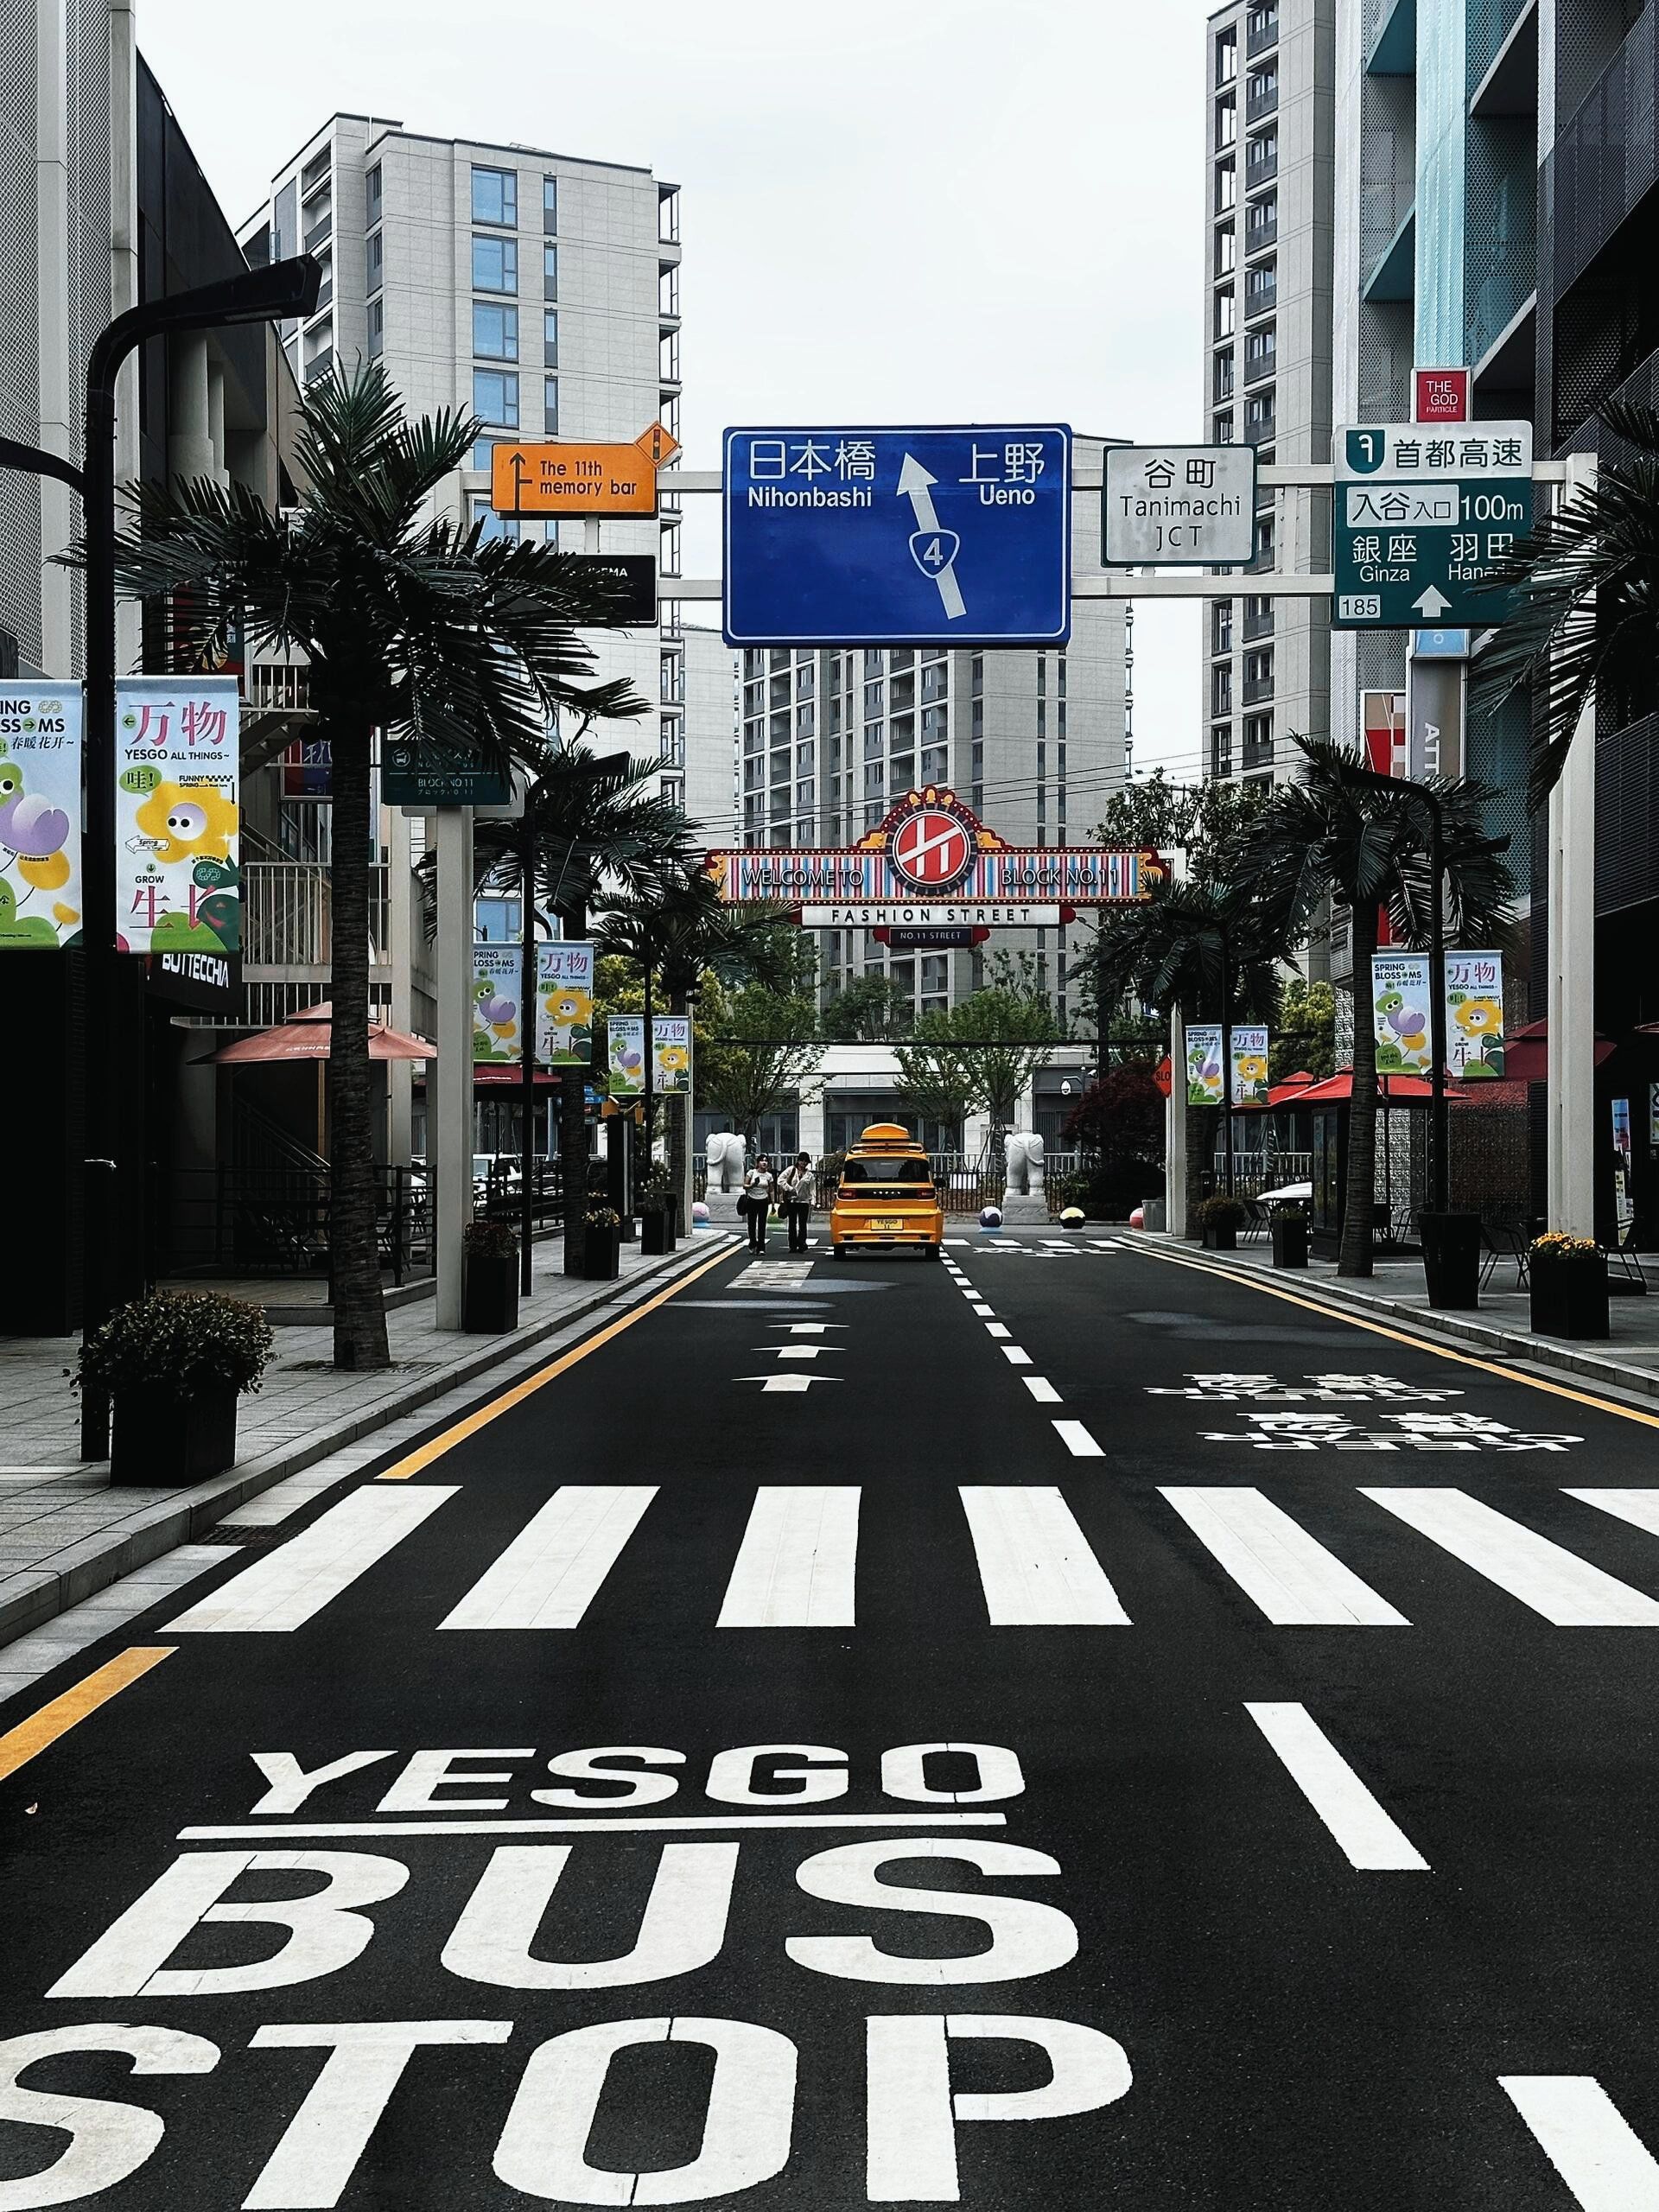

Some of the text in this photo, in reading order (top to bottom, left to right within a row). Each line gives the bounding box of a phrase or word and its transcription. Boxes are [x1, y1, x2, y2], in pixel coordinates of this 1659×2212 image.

[1426, 381, 1452, 392] THE
[1430, 394, 1458, 405] GOD
[748, 439, 875, 481] 日本橋
[1393, 438, 1522, 468] 首都高速
[540, 461, 602, 476] The 11th
[958, 443, 1044, 484] 上野
[1144, 459, 1217, 489] 谷町
[540, 480, 637, 497] memory bar
[747, 486, 872, 507] Nihonbashi
[979, 485, 1035, 505] Ueno
[1120, 494, 1241, 517] Tanimachi
[1460, 494, 1523, 520] 100m
[1155, 525, 1202, 552] JCT
[1352, 533, 1417, 563] 銀座
[923, 538, 944, 566] 4
[1360, 563, 1512, 582] Ginza Hane
[1343, 598, 1377, 616] 185
[129, 701, 227, 746] 万物
[124, 749, 168, 760] YESGO
[743, 868, 863, 886] WELCOME TO
[1001, 868, 1118, 885] BLOCK NO.11
[831, 908, 1030, 922] FASHION STREET
[543, 952, 588, 973] 万物
[1375, 963, 1405, 971] SPRING
[1451, 962, 1495, 982] 万物
[657, 1023, 684, 1037] 万物
[1236, 1033, 1263, 1046] 万物
[1156, 1072, 1171, 1082] SLO
[1253, 1441, 1570, 1452] KEEP
[251, 1742, 1026, 1815] YESGO
[43, 1838, 1080, 1998] BUS
[0, 2013, 1133, 2210] STOP
